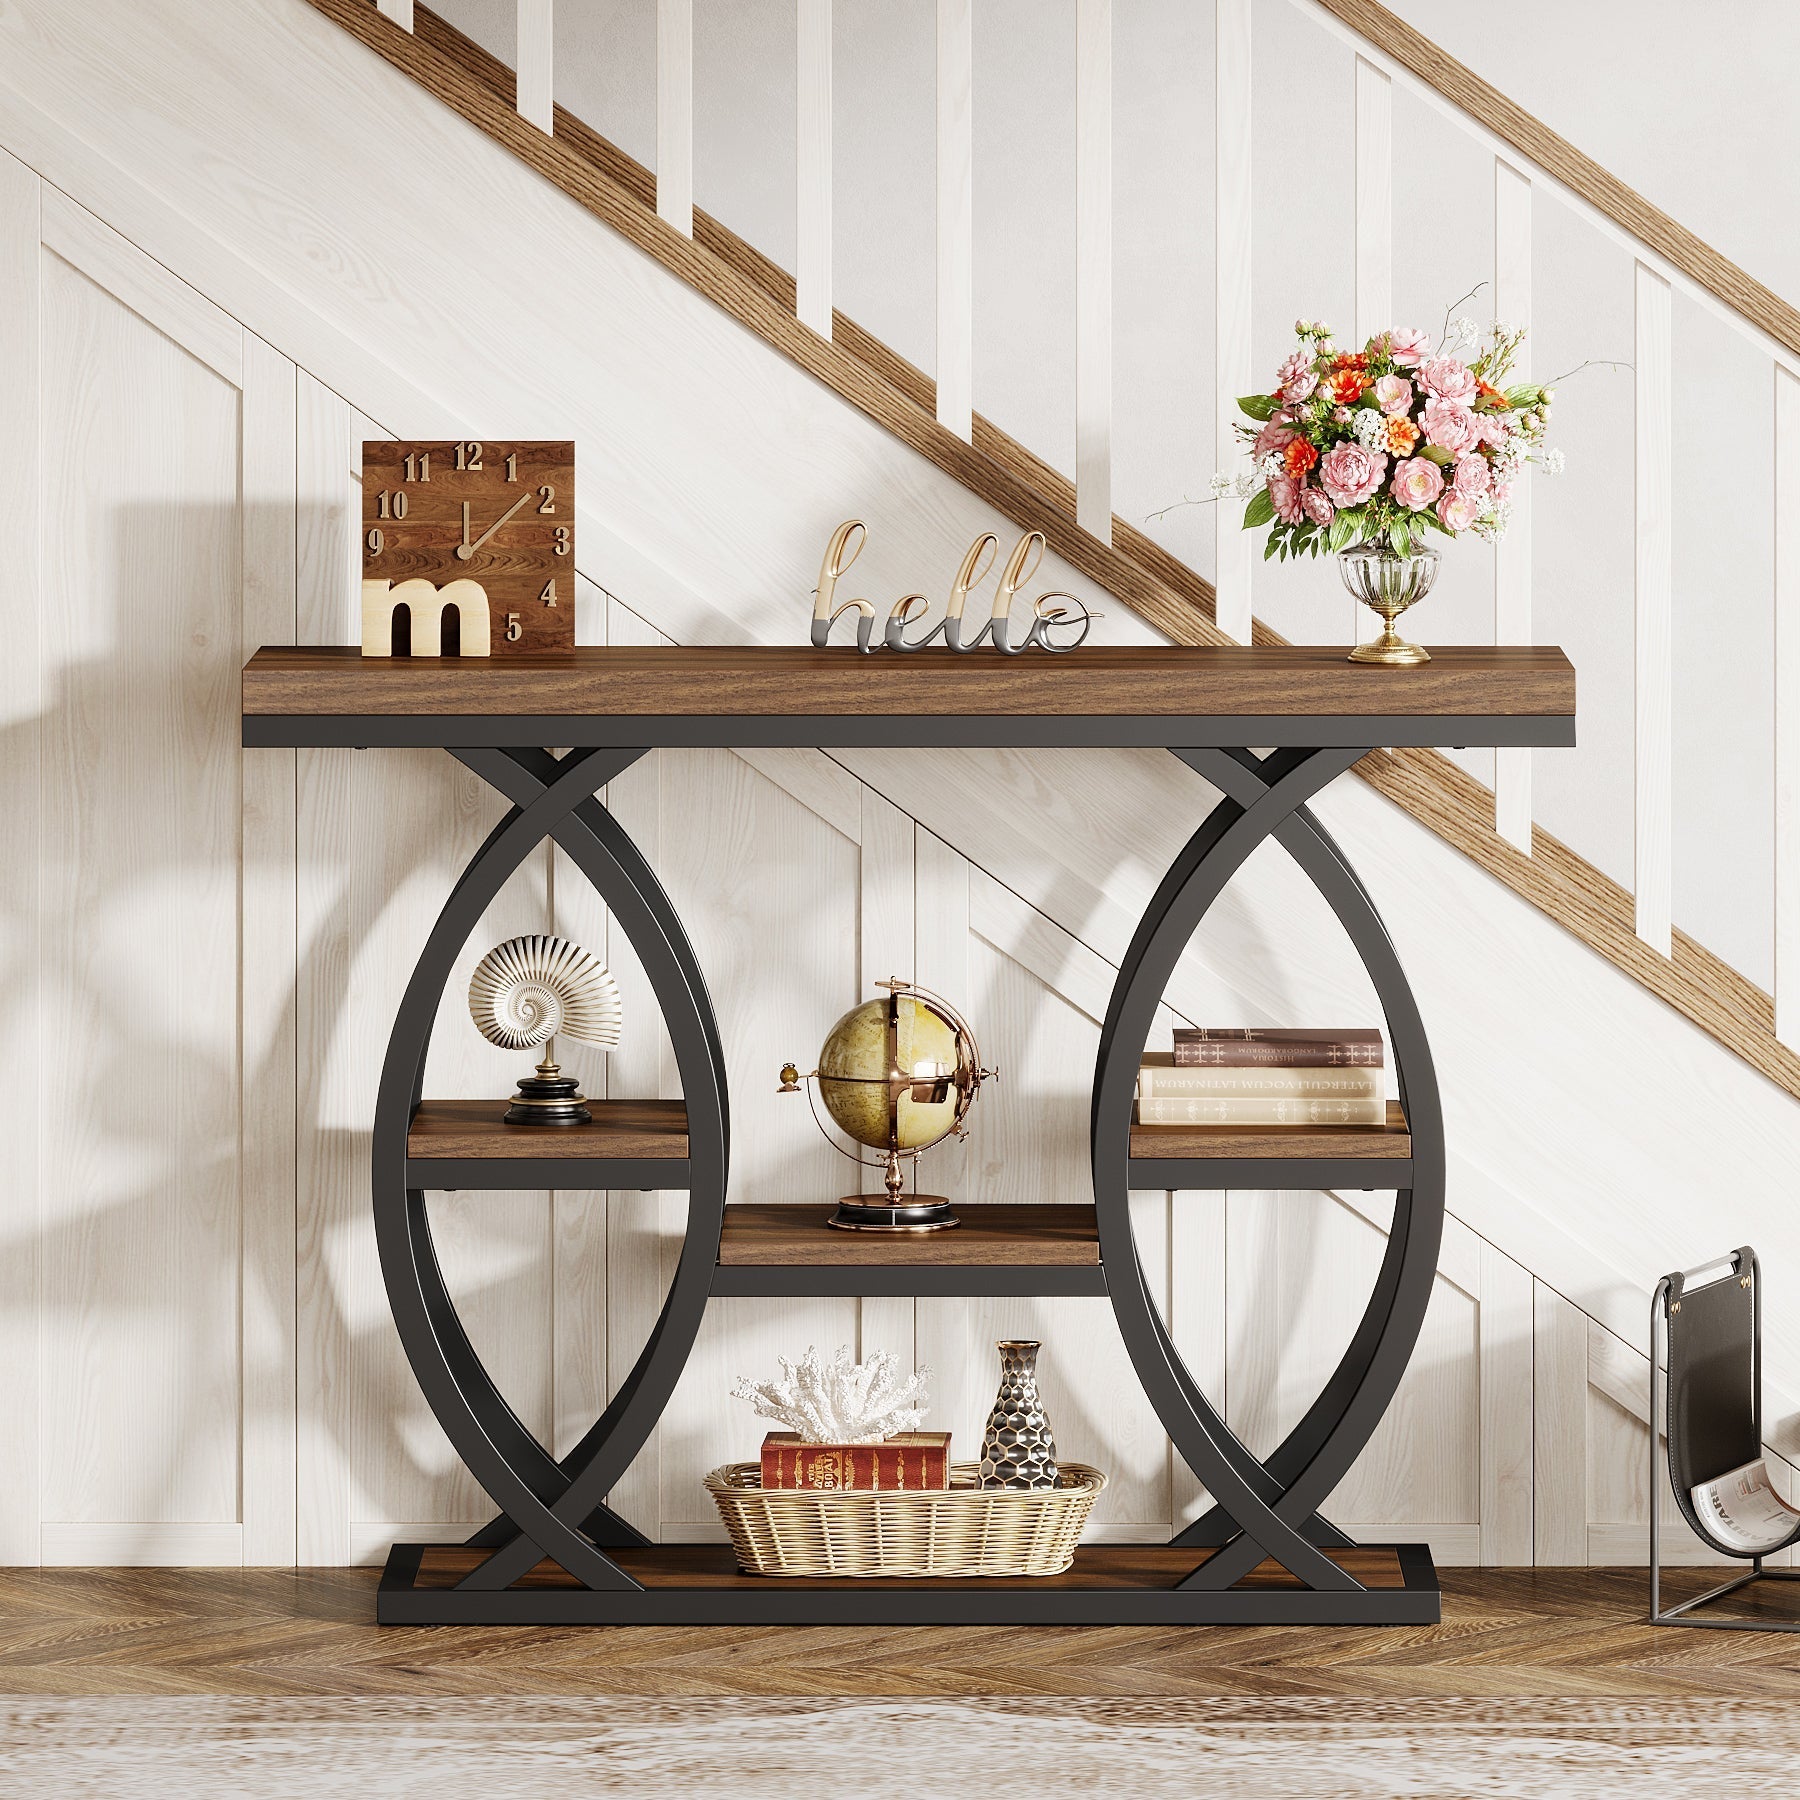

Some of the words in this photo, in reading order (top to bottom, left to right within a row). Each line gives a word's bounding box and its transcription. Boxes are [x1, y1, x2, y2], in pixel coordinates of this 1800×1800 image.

[403, 452, 431, 482] 11
[453, 441, 483, 471] 12
[506, 452, 518, 482] 1
[377, 489, 409, 520] 10
[538, 485, 556, 514] 2
[367, 528, 385, 557] 9
[554, 526, 571, 556] 3
[540, 578, 558, 608] 4
[810, 519, 1105, 656] hello
[506, 612, 523, 641] 5
[1155, 1079, 1237, 1089] LATINARUM
[1241, 1079, 1295, 1089] VOCUM
[824, 1457, 834, 1488] BOAT
